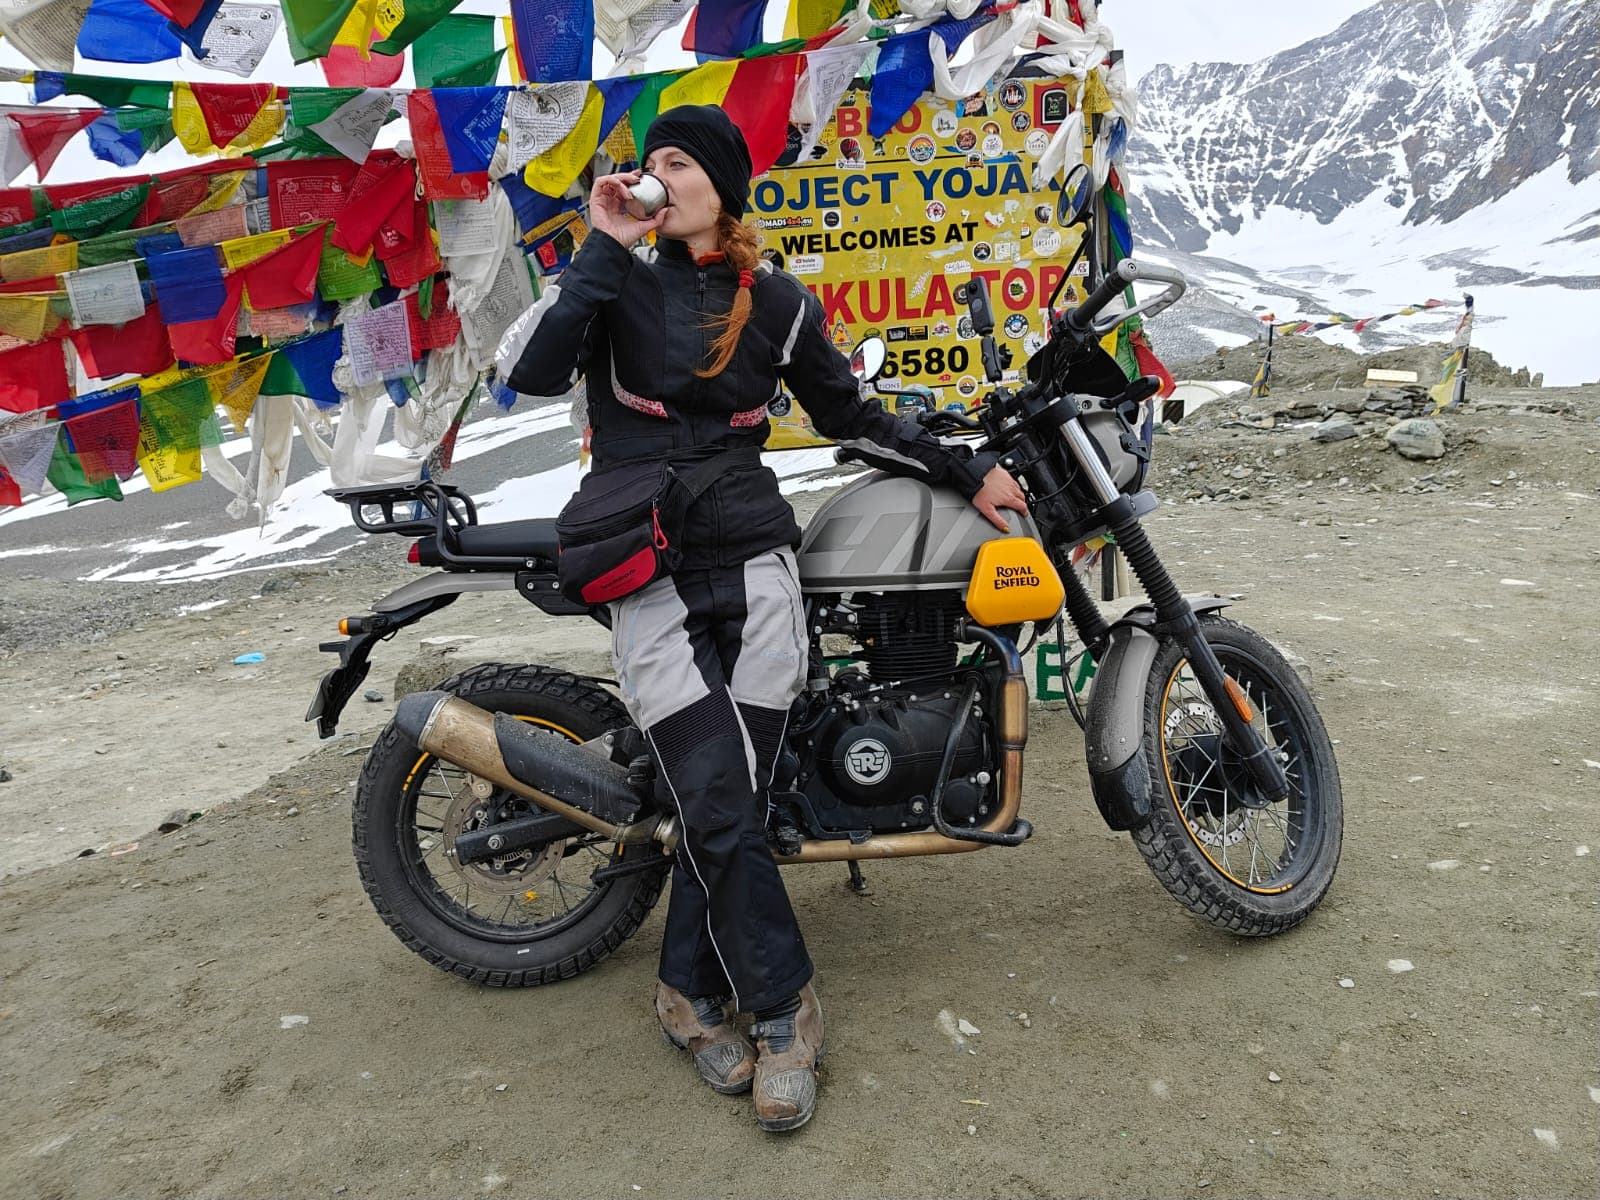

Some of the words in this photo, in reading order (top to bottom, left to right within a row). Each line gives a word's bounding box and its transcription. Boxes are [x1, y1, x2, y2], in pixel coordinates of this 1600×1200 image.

[836, 104, 922, 138] BO
[743, 173, 899, 213] OJECT
[781, 225, 936, 256] WELCOMES
[944, 222, 979, 243] AT
[807, 273, 956, 326] KULA
[878, 345, 969, 380] 6580
[994, 576, 1040, 590] ENFIELD
[996, 566, 1034, 578] ROYAL
